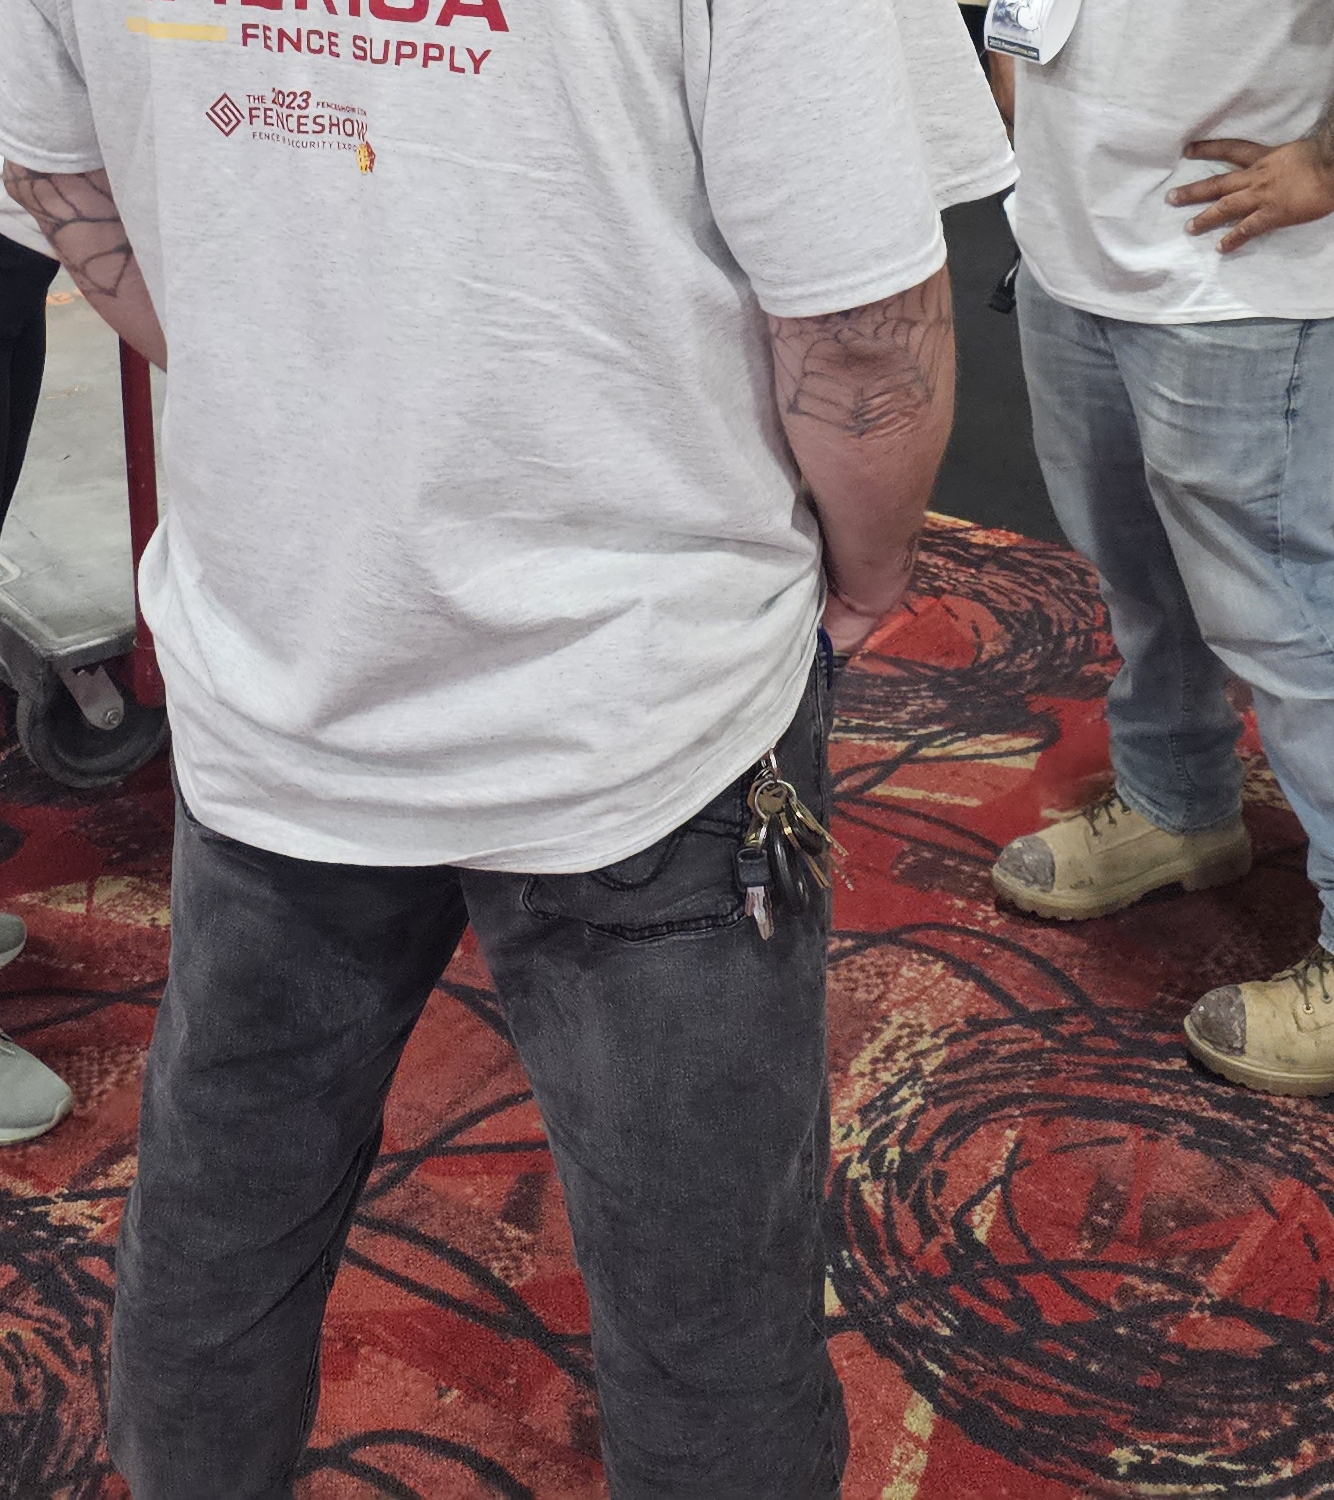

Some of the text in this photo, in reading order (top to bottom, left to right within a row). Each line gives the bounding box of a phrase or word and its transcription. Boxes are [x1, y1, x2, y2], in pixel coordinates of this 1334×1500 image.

[241, 23, 492, 75] FENCE SUPPLY
[246, 94, 267, 104] THE
[272, 87, 311, 111] 2023
[248, 106, 368, 142] FENCESHOW
[252, 131, 280, 142] FENCE
[287, 138, 334, 149] SECURITY
